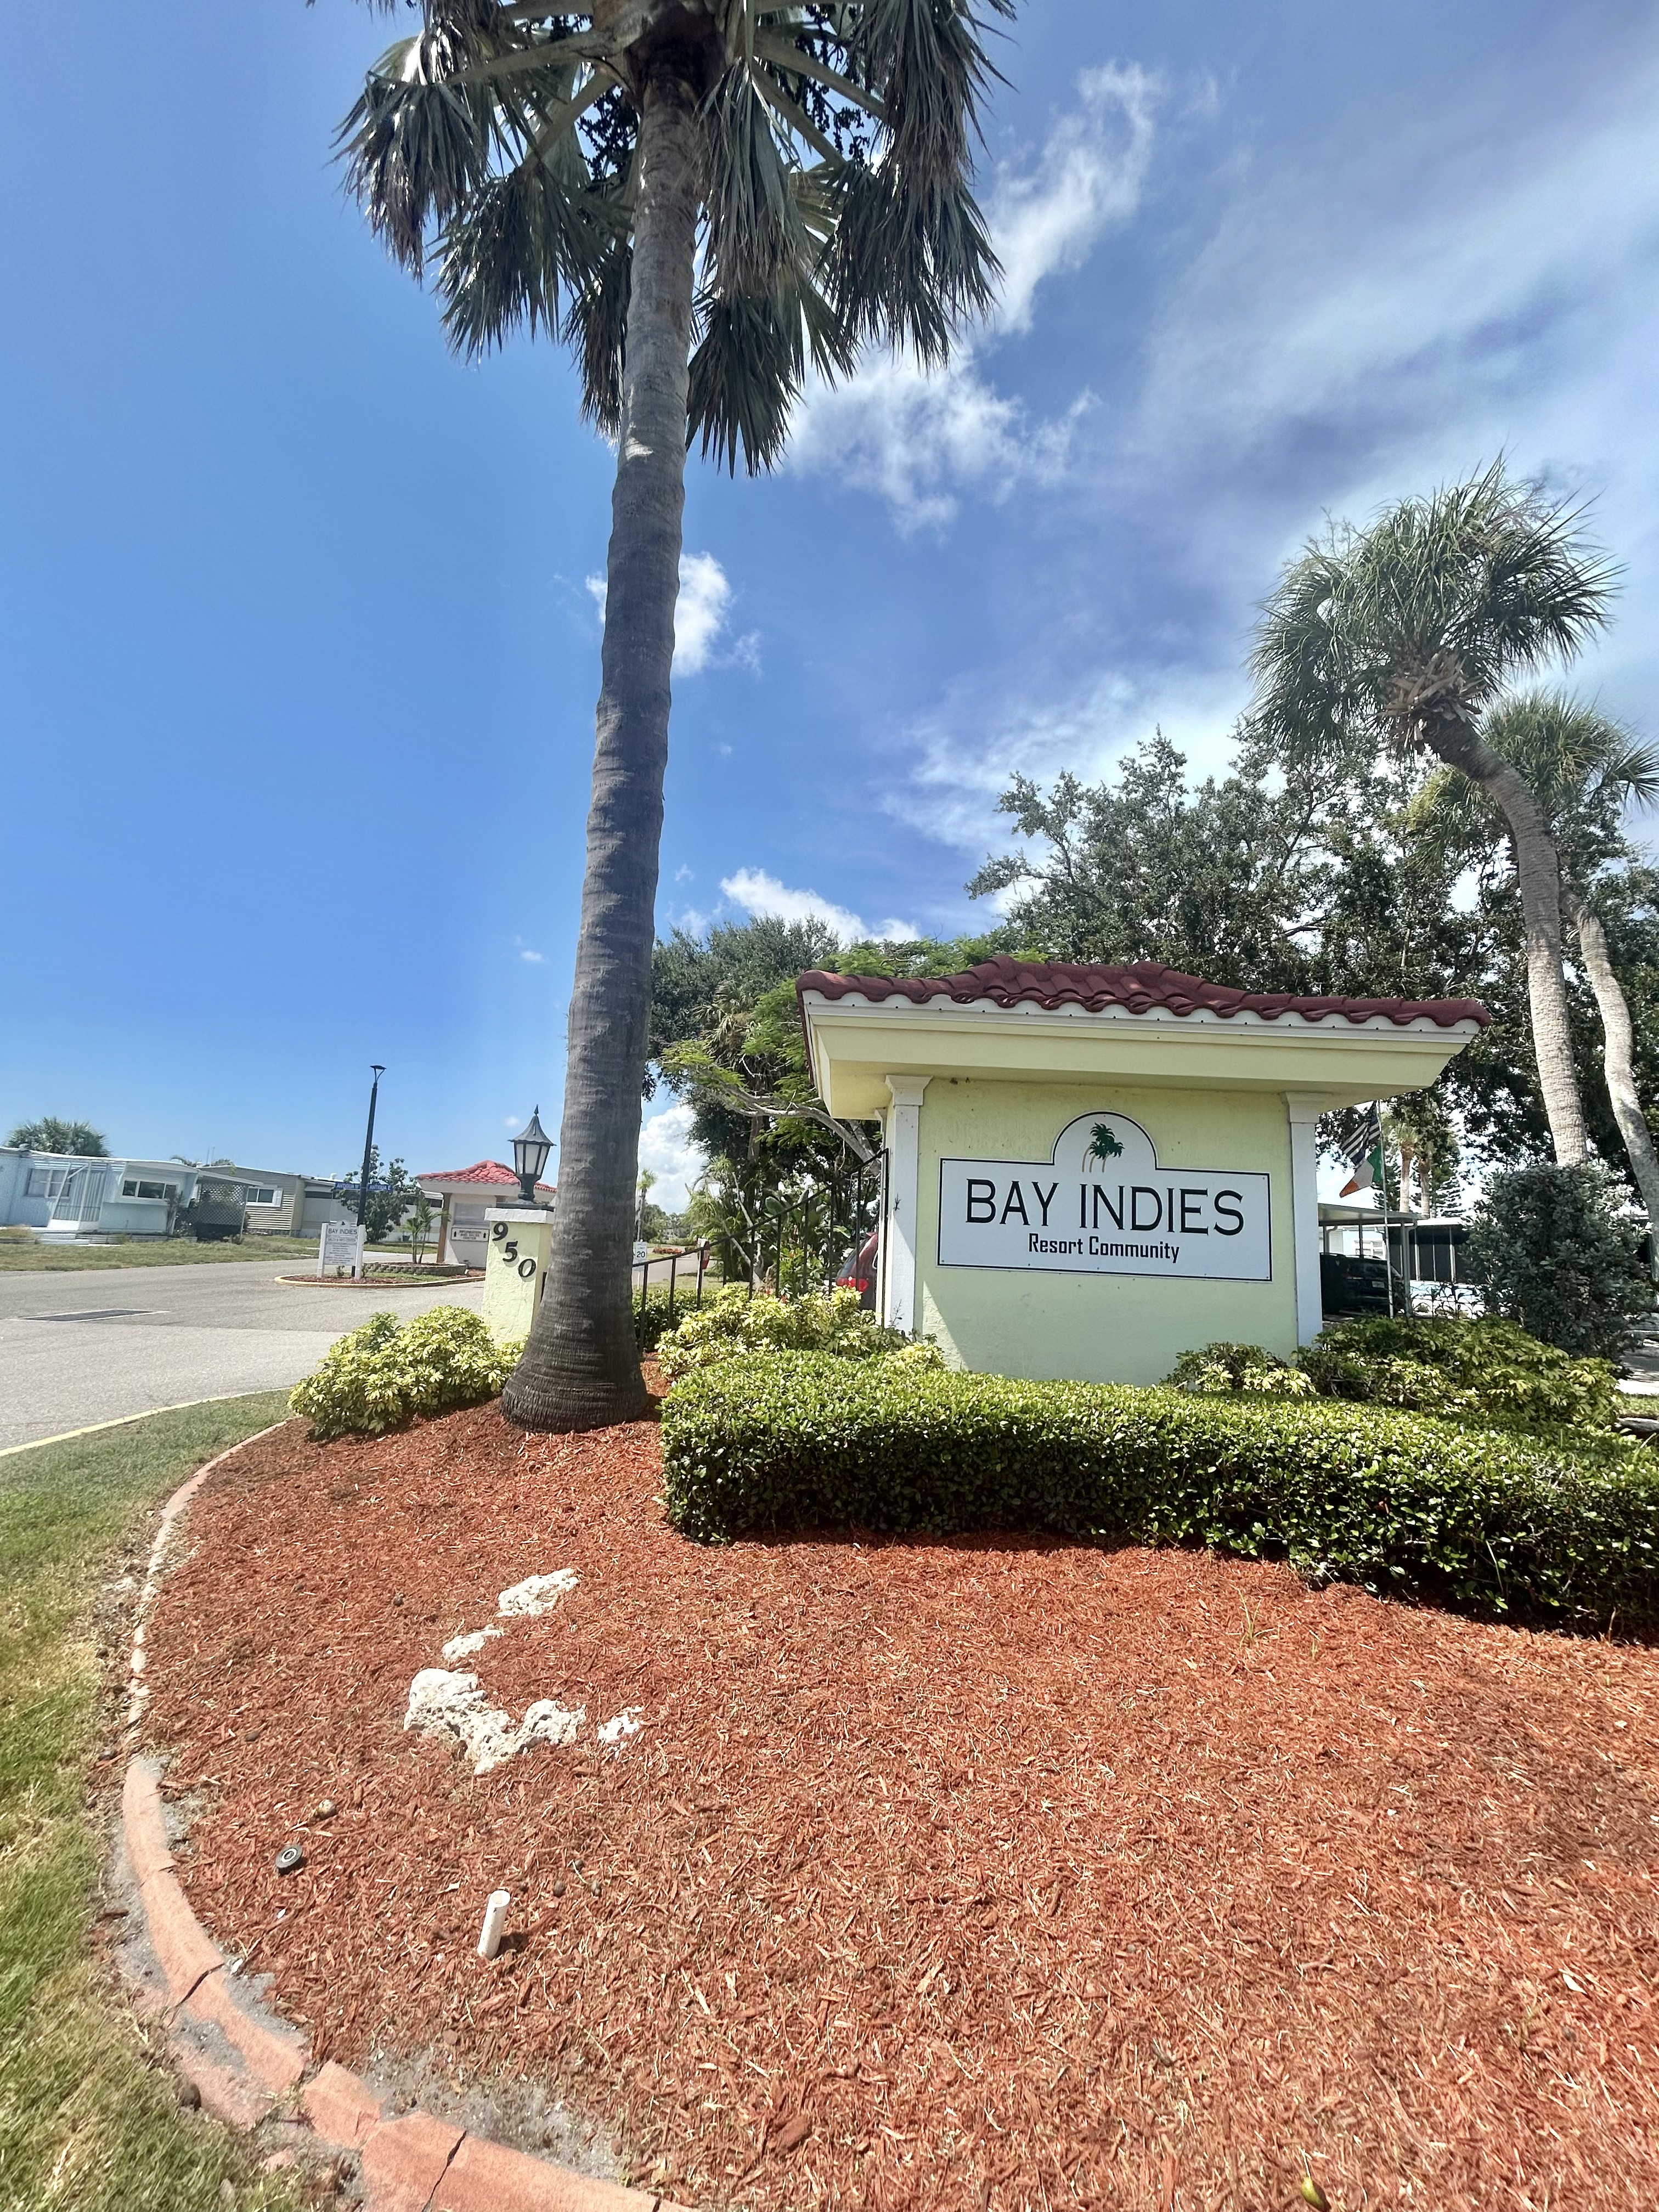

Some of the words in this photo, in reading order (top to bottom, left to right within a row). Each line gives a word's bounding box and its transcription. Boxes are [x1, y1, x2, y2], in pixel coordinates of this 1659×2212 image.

[966, 1178, 1059, 1227] BAY
[1079, 1183, 1244, 1236] INDIES
[1029, 1233, 1084, 1255] Resort
[1088, 1235, 1180, 1263] Community
